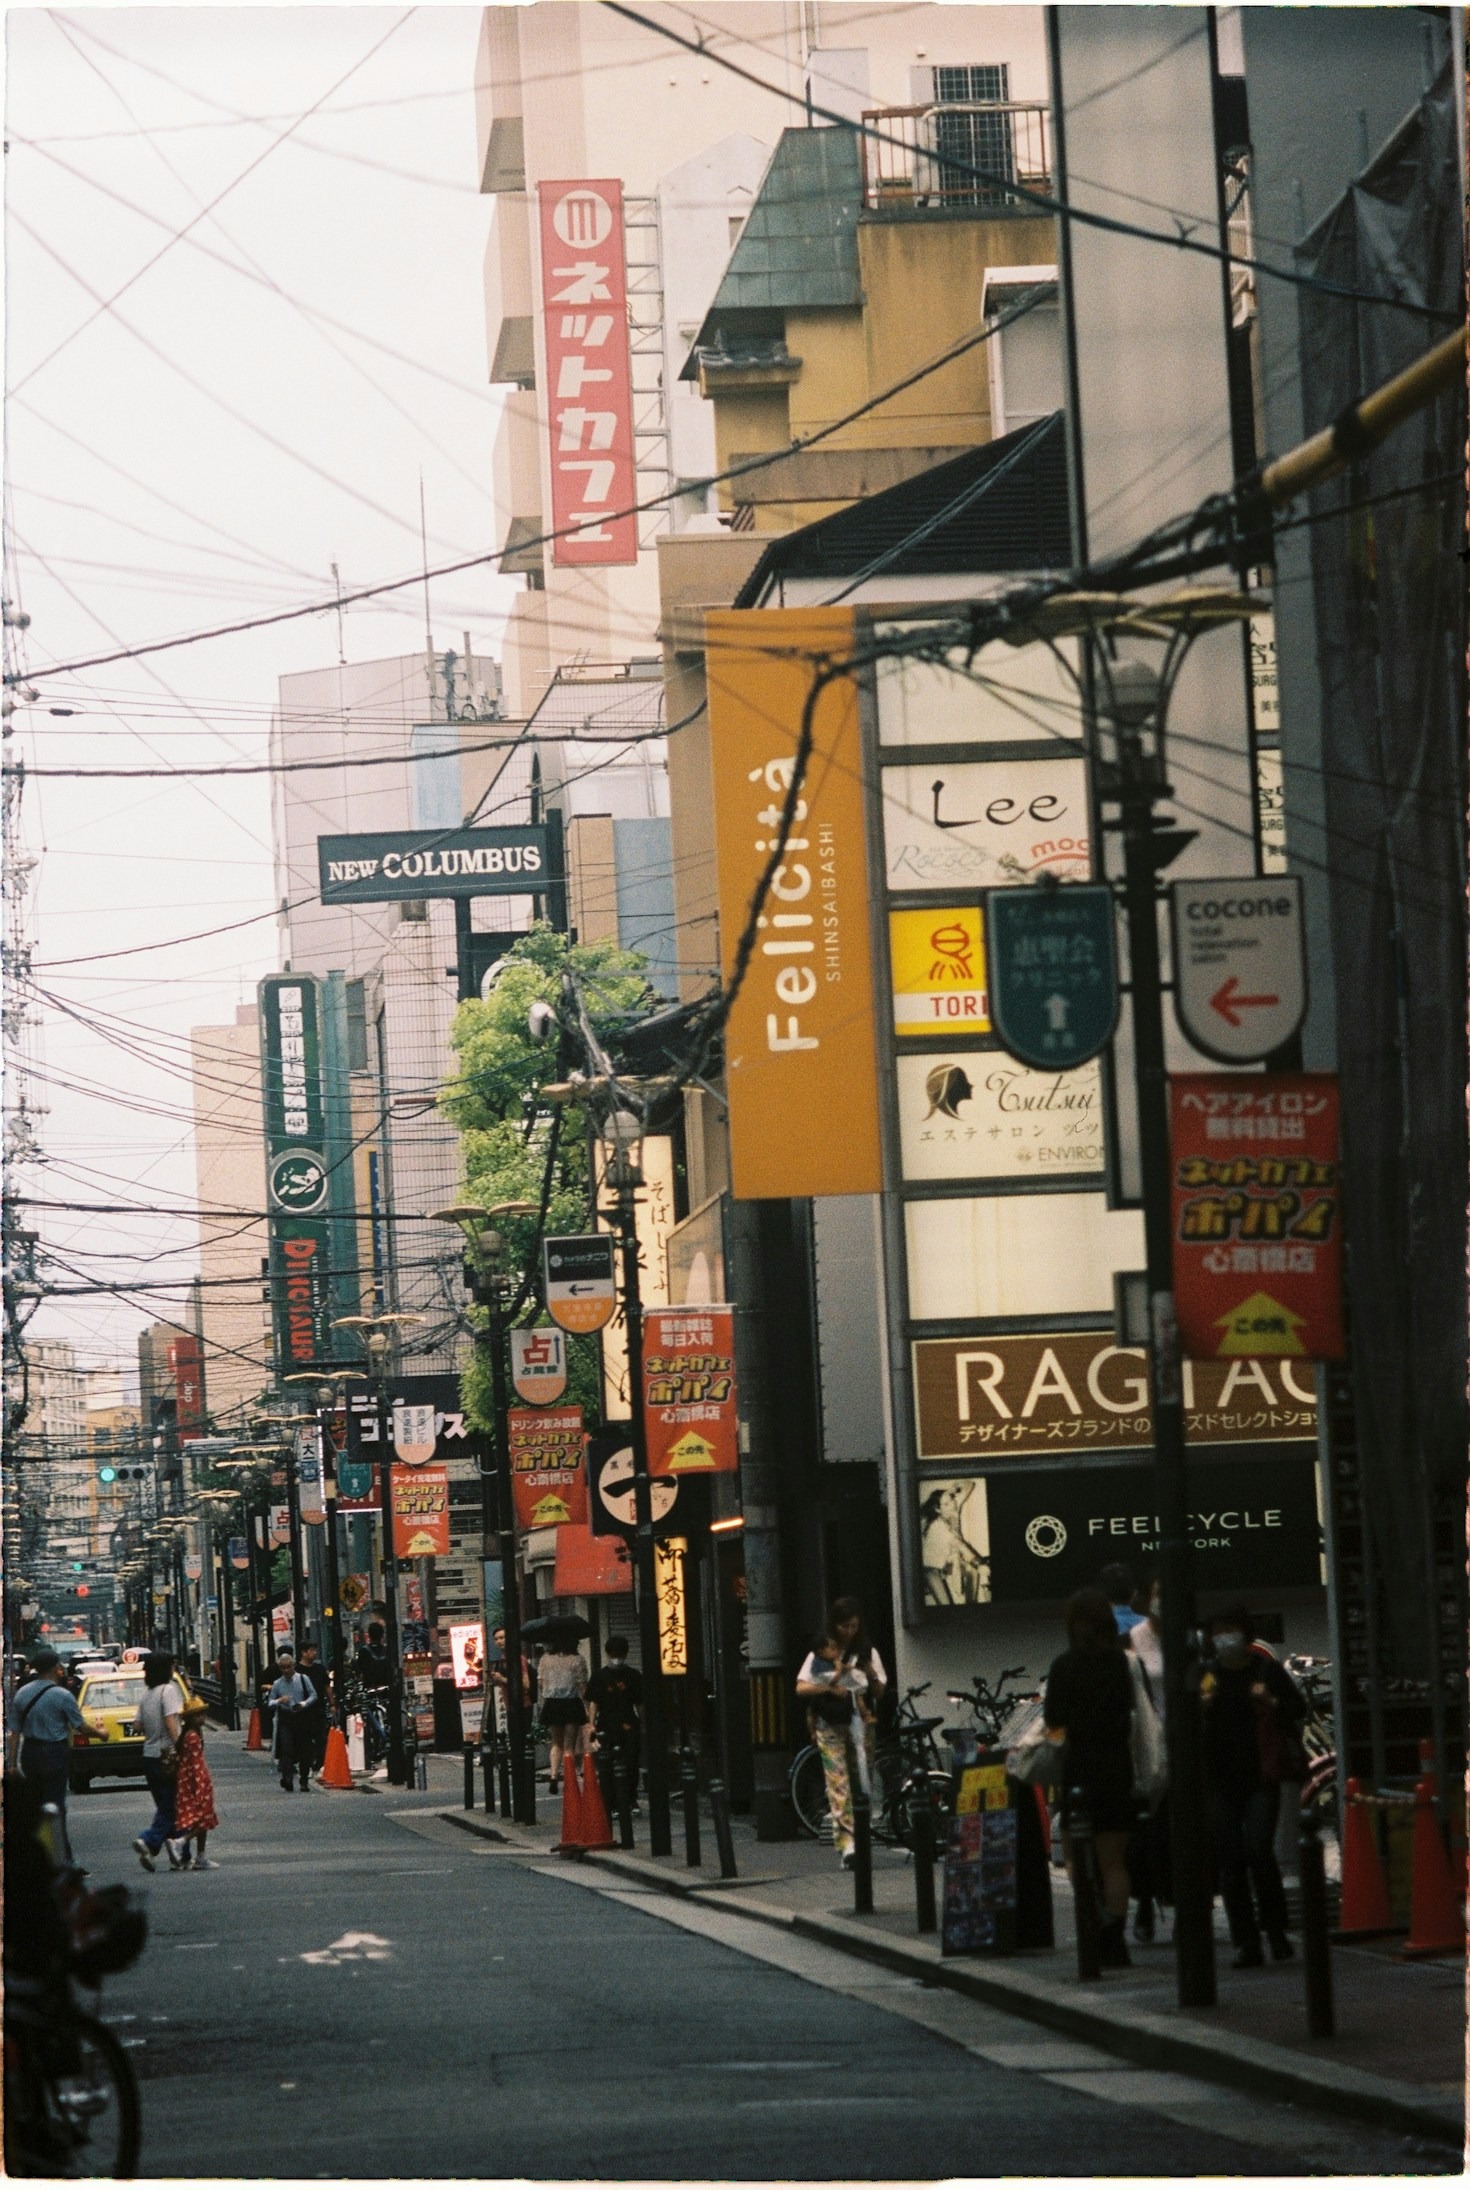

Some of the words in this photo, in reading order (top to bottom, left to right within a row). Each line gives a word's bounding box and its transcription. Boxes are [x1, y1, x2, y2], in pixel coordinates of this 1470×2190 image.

[550, 262, 617, 542] ネットカフェ
[931, 780, 1068, 829] Lee
[328, 859, 379, 881] NEW
[382, 845, 543, 879] COLUMBUS
[748, 755, 820, 1052] Felicità
[819, 822, 841, 982] SHINSAIBASHI
[1186, 897, 1291, 919] cocone
[1181, 1091, 1328, 1116] ヘアアイロン
[919, 1125, 1045, 1142] エステサロン
[1179, 1155, 1333, 1188] ネットカフェ
[1179, 1192, 1333, 1242] ポパイ
[523, 1335, 552, 1365] 占
[646, 1355, 731, 1374] ネットカフェ
[647, 1374, 732, 1405] ポパイ
[514, 1431, 580, 1448] ネットカフェ
[958, 1410, 1317, 1444] デザイナーズブランドのズドセレクトショ
[514, 1447, 582, 1472] ポパイ
[395, 1485, 446, 1497] ネットカフェ
[396, 1497, 446, 1514] ポパイ
[1089, 1509, 1283, 1535] FEEYCLE
[1189, 1537, 1231, 1549] ORK
